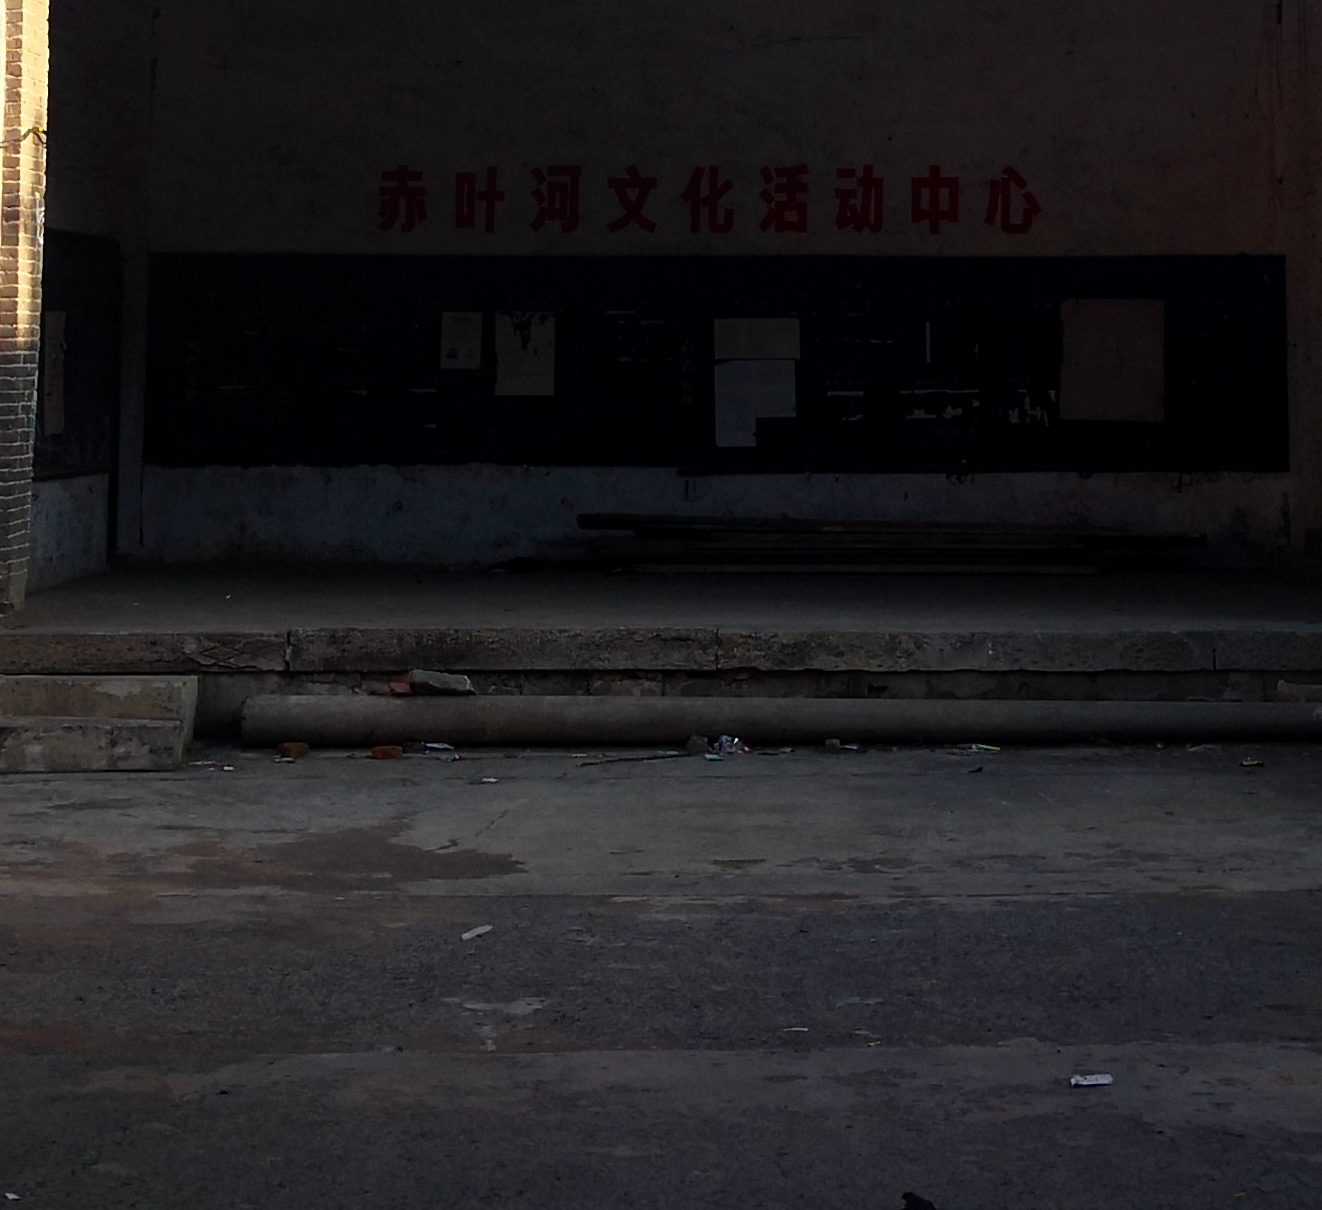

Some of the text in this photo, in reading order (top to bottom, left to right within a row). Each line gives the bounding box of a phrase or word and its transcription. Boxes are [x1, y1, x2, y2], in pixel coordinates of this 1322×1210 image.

[378, 165, 1042, 234] 赤叶河文化活动中心
